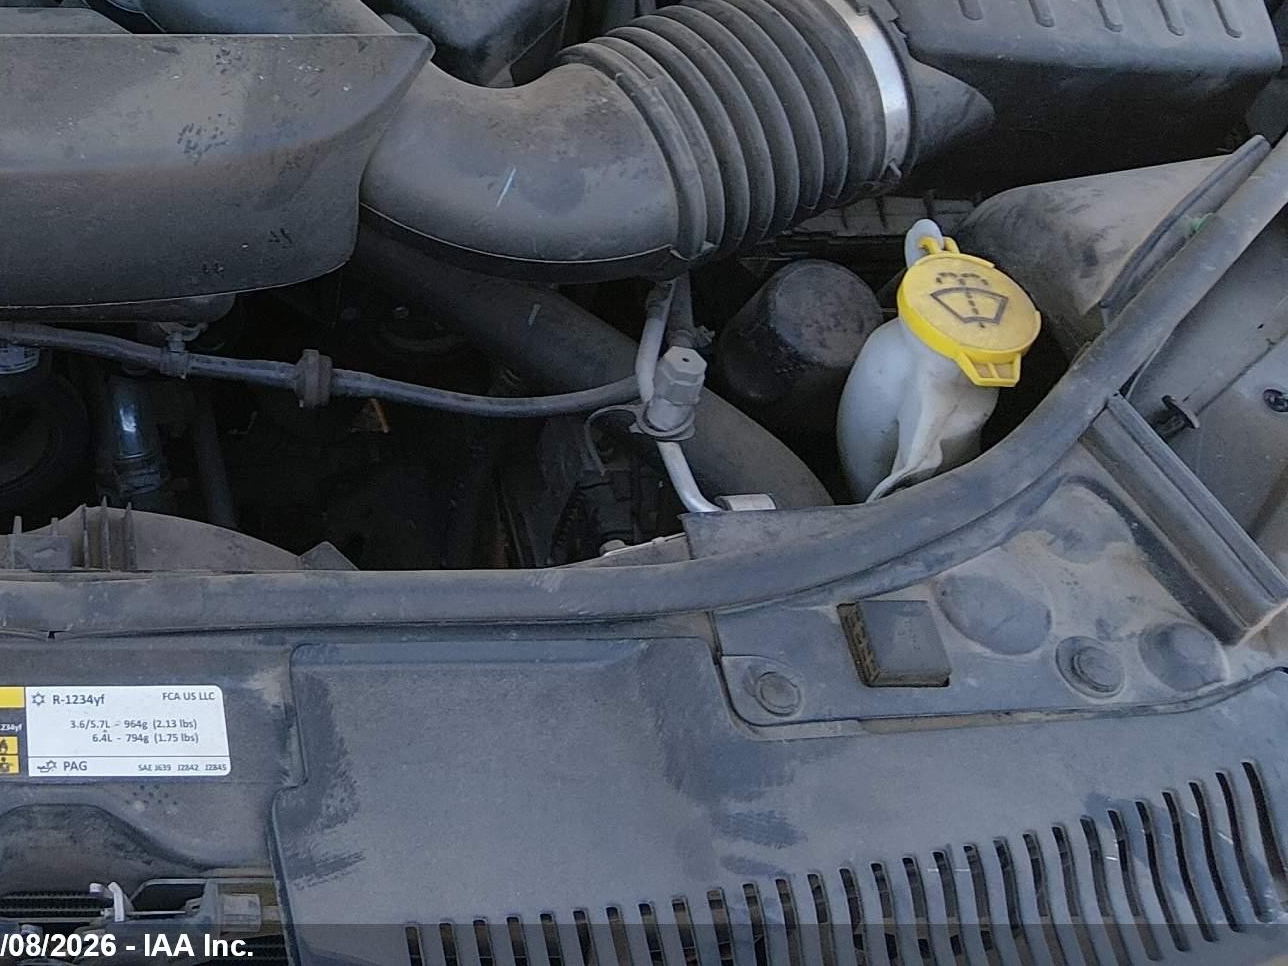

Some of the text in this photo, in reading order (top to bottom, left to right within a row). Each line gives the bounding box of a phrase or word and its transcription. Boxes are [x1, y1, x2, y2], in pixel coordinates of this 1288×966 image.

[52, 694, 105, 706] R-1234yf
[162, 691, 215, 701] FCA US LLC
[70, 719, 111, 731] 3.6/5.7L
[123, 720, 148, 731] 964g
[152, 719, 176, 731] (2.13
[179, 719, 197, 730] lbs)
[92, 732, 112, 743] 6.4L
[126, 733, 149, 744] 794g
[154, 733, 178, 744] (1.75
[181, 733, 199, 744] lbs)
[63, 760, 88, 771] PAG
